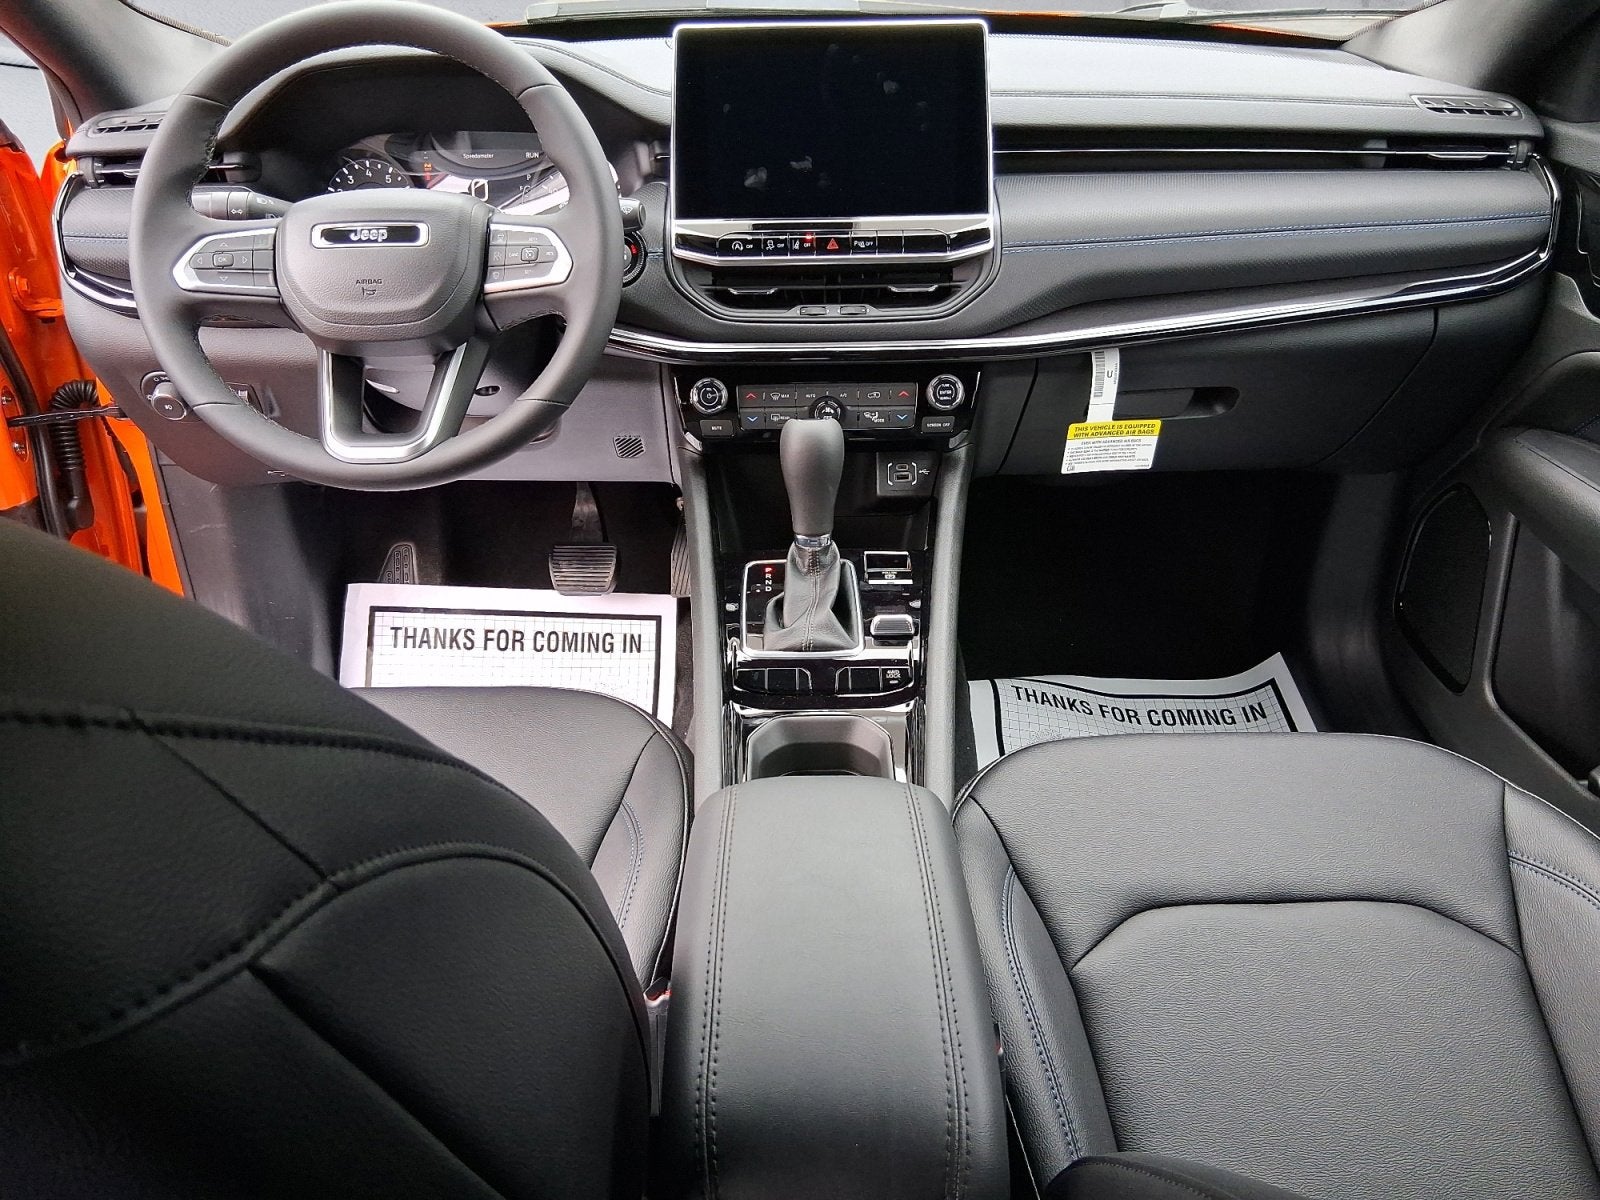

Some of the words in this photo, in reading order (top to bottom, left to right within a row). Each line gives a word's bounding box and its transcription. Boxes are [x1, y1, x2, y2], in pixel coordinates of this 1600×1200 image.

[462, 153, 495, 161] Speedometer
[365, 170, 373, 178] 4
[525, 174, 532, 182] P
[347, 176, 355, 184] 3
[385, 175, 393, 184] 5
[350, 228, 388, 242] Jeep
[356, 278, 383, 286] AIRBAG
[1106, 370, 1114, 378] U
[390, 626, 476, 651] THANKS
[483, 629, 525, 652] FOR
[533, 630, 615, 654] COMING
[622, 633, 642, 654] IN
[1010, 684, 1094, 716] THANKS
[1099, 703, 1142, 726] FOR
[1147, 706, 1236, 728] COMING
[1242, 701, 1268, 723] IN
